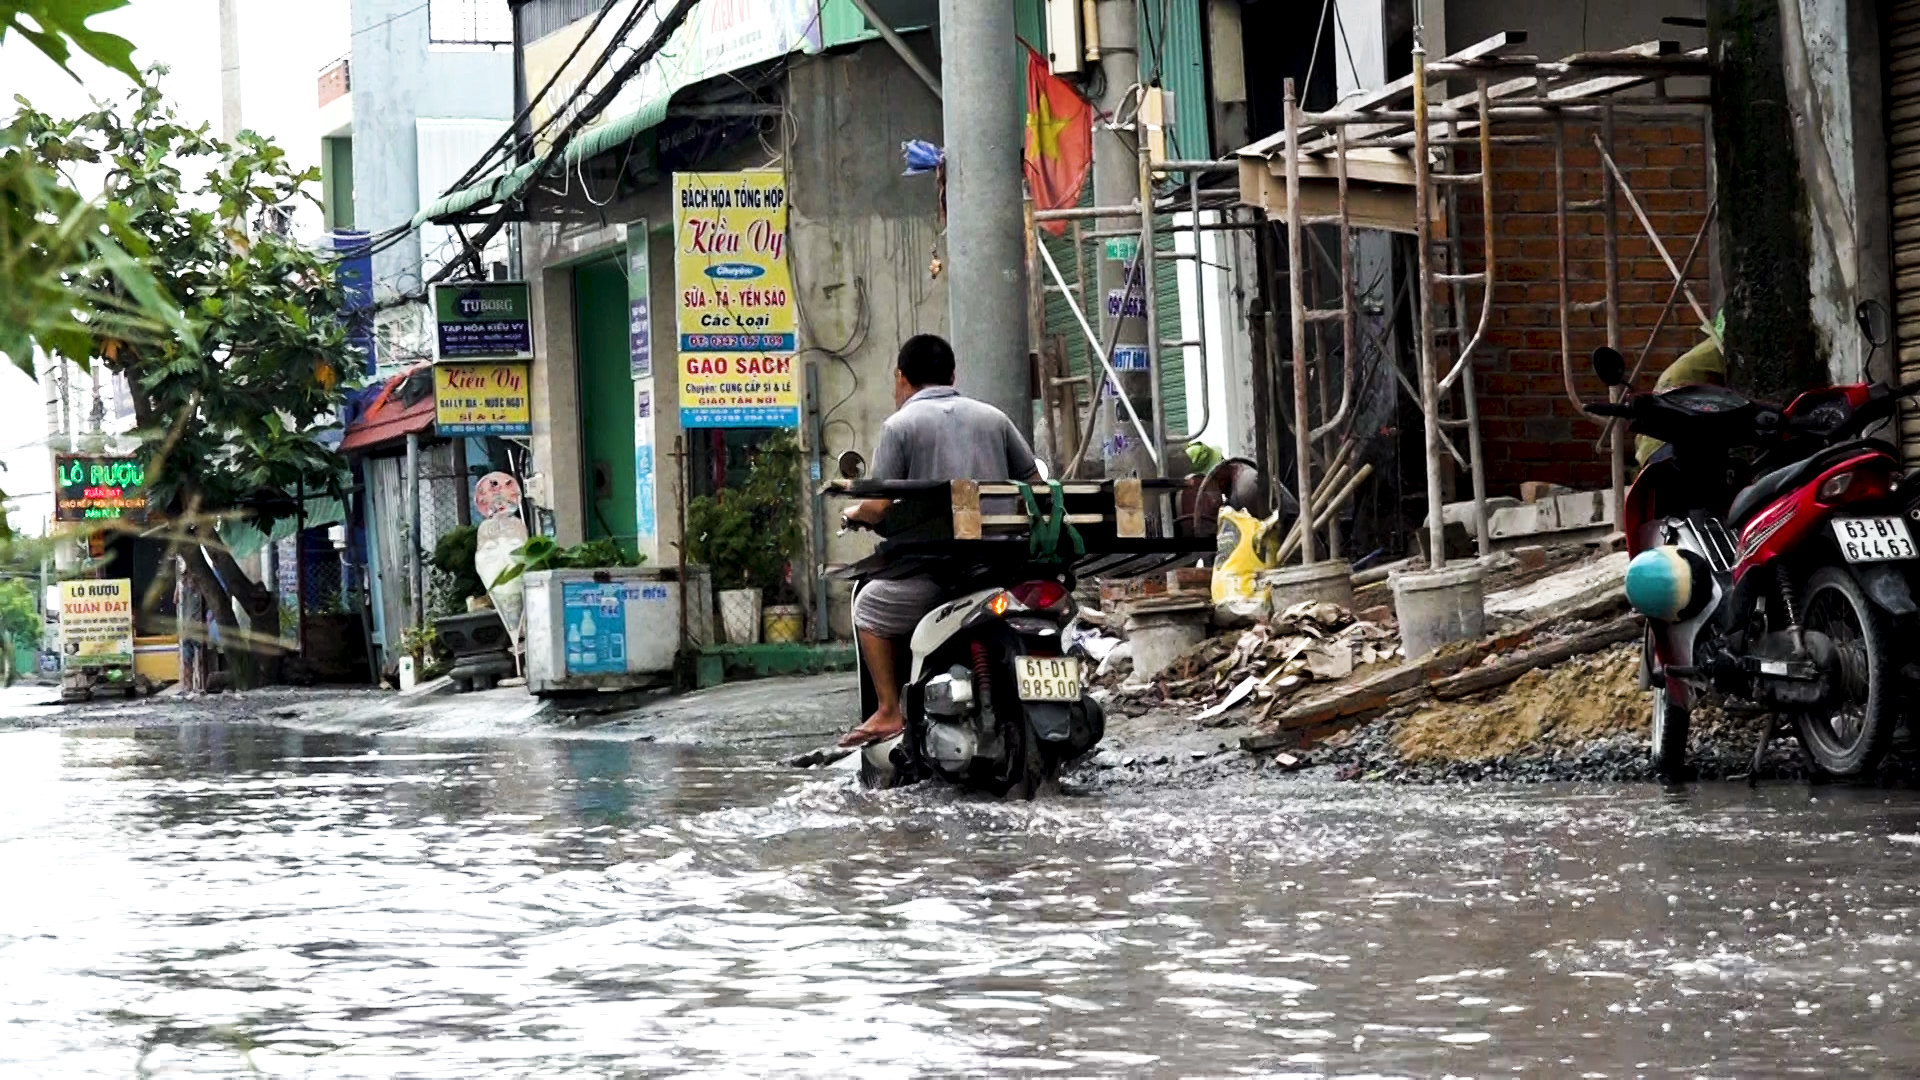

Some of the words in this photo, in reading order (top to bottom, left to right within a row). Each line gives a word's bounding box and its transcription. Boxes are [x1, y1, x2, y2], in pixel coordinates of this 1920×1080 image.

[681, 183, 708, 208] BÁCH
[734, 179, 761, 208] TỔNG
[764, 186, 784, 213] HỢP
[684, 217, 739, 254] Kiều
[746, 219, 783, 259] Vy
[684, 285, 706, 307] SỮA
[739, 284, 761, 307] YẾN
[461, 299, 513, 313] TUBORG
[701, 313, 730, 327] Các
[736, 313, 769, 330] Loại
[686, 357, 728, 377] GẠO
[736, 357, 790, 377] SẠCH
[490, 367, 521, 391] Vy
[720, 383, 742, 394] CUNG
[745, 380, 761, 392] CẤP
[58, 459, 84, 487] LÒ
[90, 462, 145, 488] RƯỢU
[1845, 519, 1897, 539] 63-B1
[1026, 660, 1068, 678] 61-D1
[1022, 679, 1077, 698] 985.00
